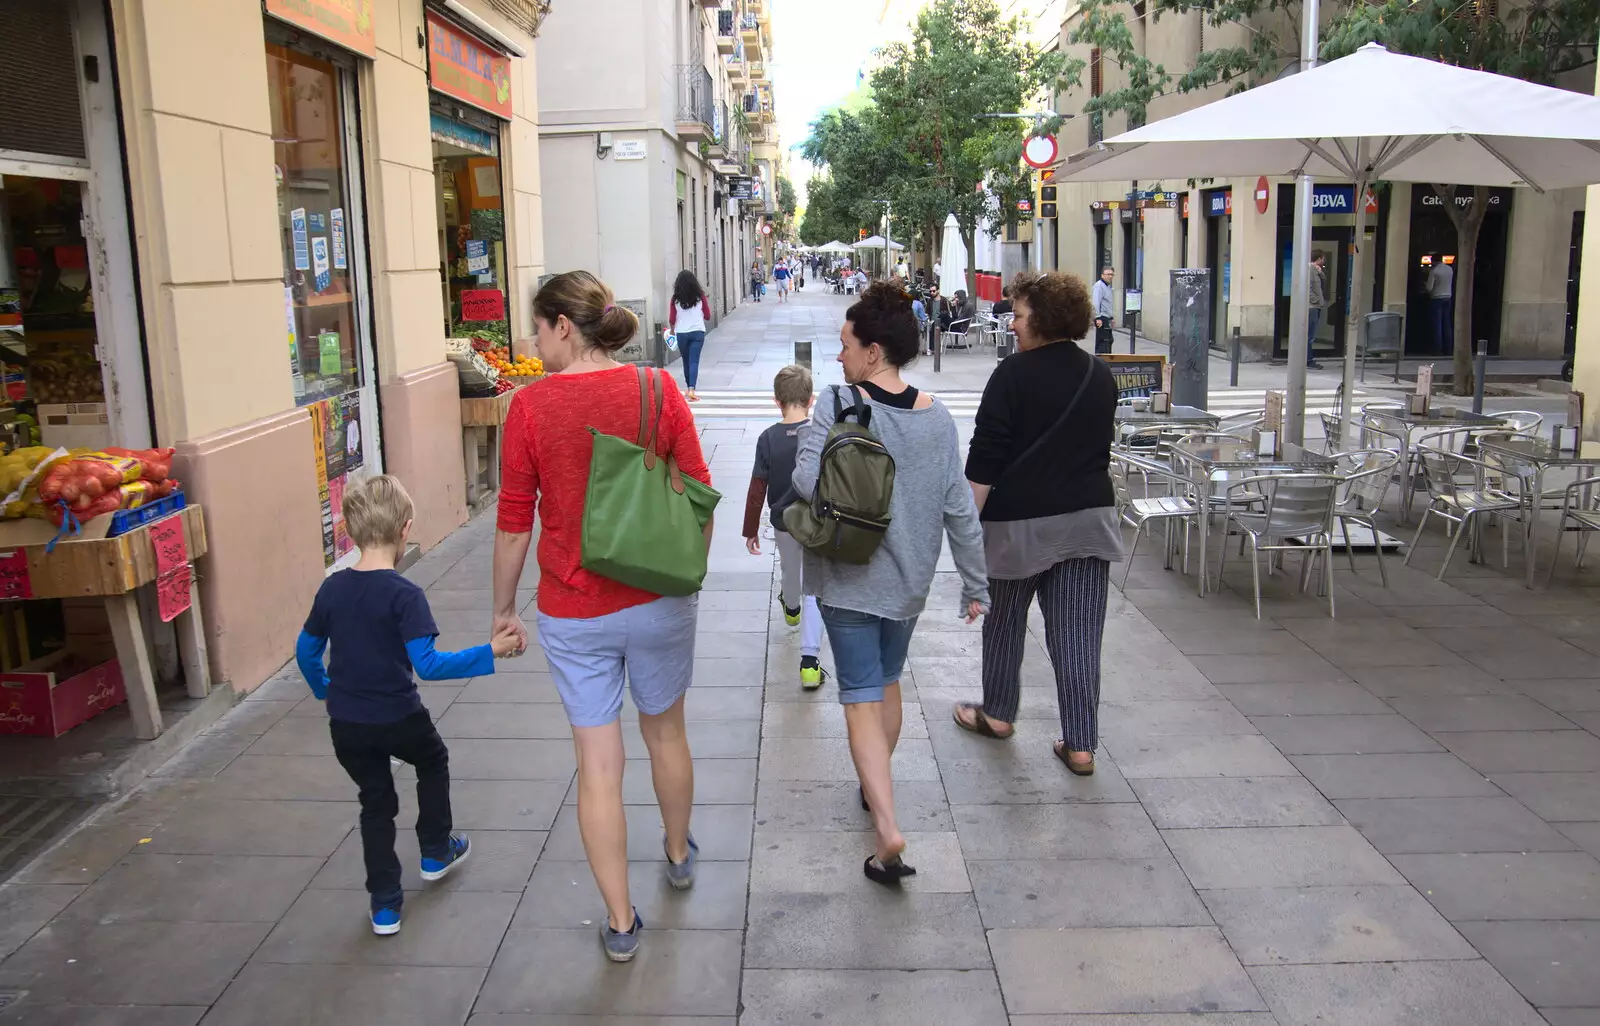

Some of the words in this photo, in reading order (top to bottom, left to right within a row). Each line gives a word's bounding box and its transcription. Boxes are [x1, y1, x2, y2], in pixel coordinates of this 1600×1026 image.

[1312, 194, 1347, 208] BBVA
[1365, 194, 1377, 207] X
[1113, 374, 1141, 390] INCHO
